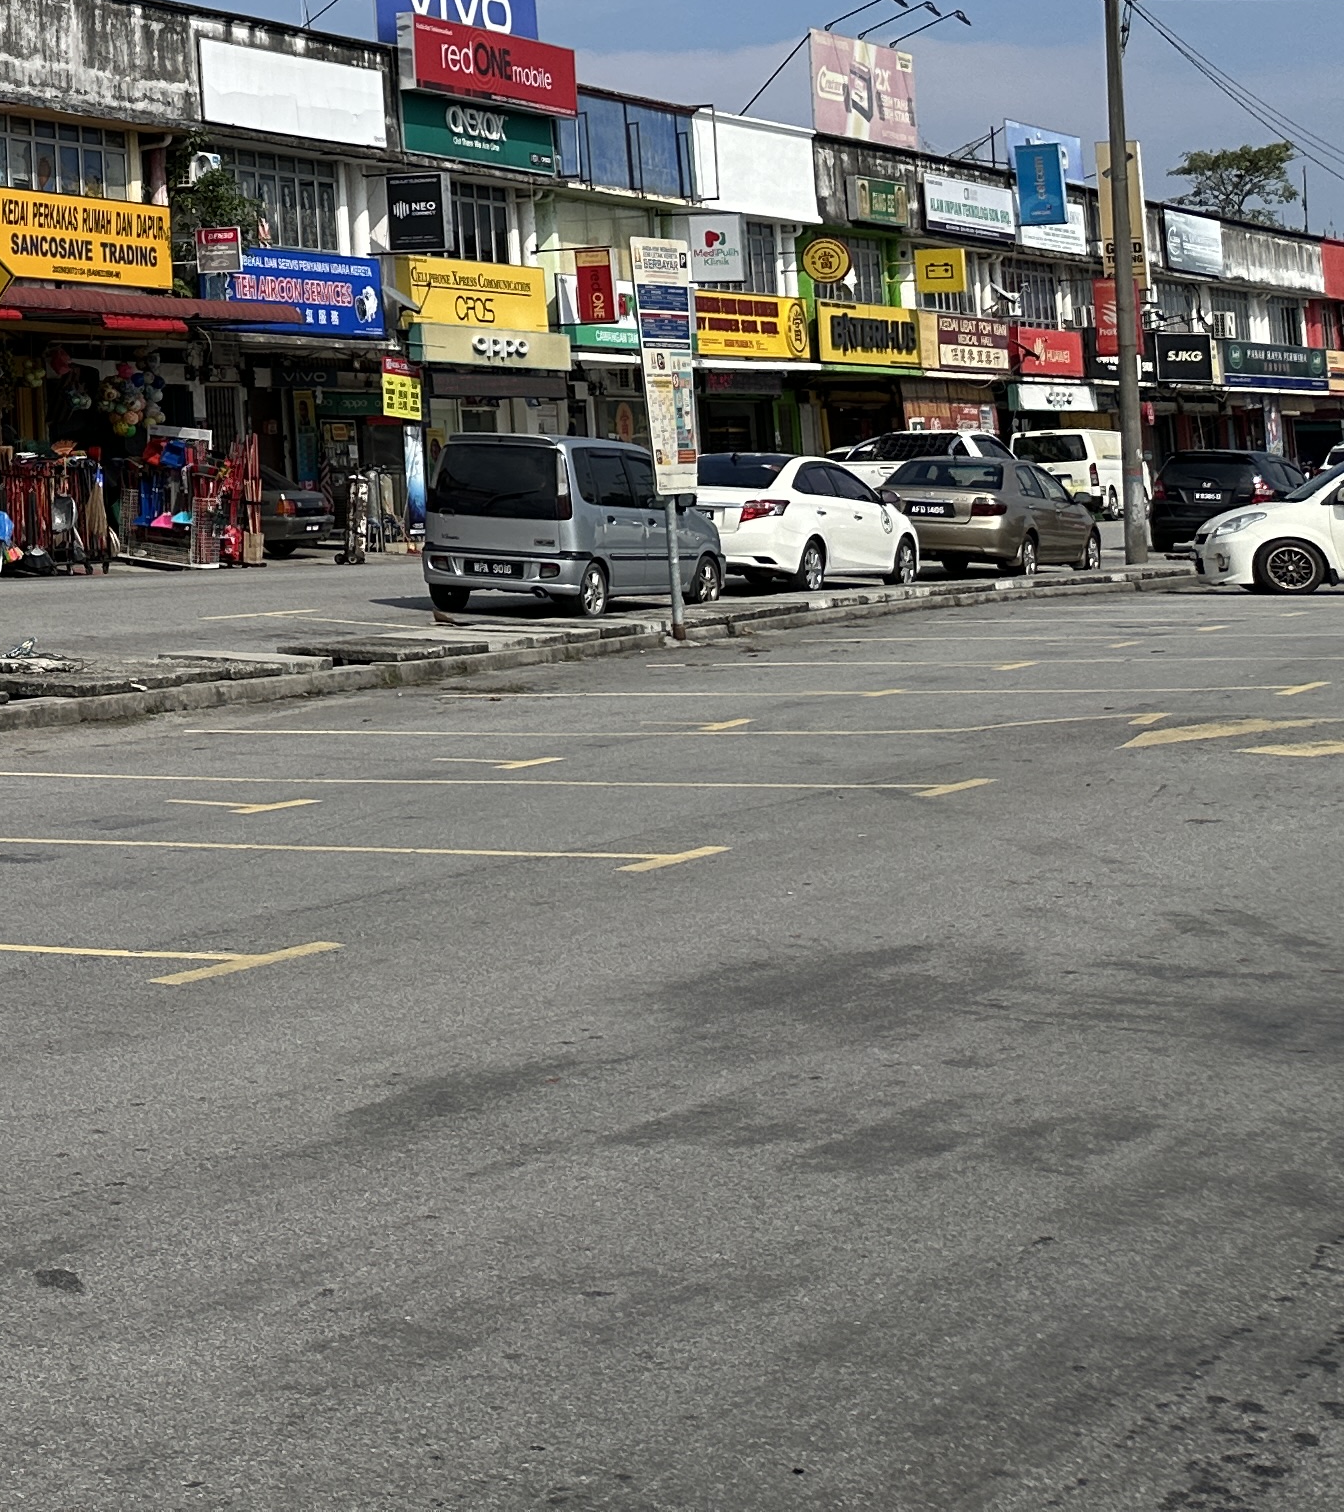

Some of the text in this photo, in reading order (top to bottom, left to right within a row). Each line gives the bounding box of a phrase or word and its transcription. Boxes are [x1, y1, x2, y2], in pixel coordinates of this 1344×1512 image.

[440, 41, 552, 90] redONE mobile
[411, 201, 436, 211] NEO
[1, 198, 165, 240] KEDAI PERKAKAS RUMAH DAN DAPUR
[10, 232, 158, 268] SANCOSAVE TRADING
[1106, 242, 1142, 255] GD
[233, 274, 354, 307] TEH AIRCON SERVICES
[939, 318, 958, 332] KEDAI
[959, 320, 976, 333] UBAT
[981, 336, 994, 347] HALL
[1167, 350, 1203, 362] SJKG
[283, 370, 328, 383] vivo
